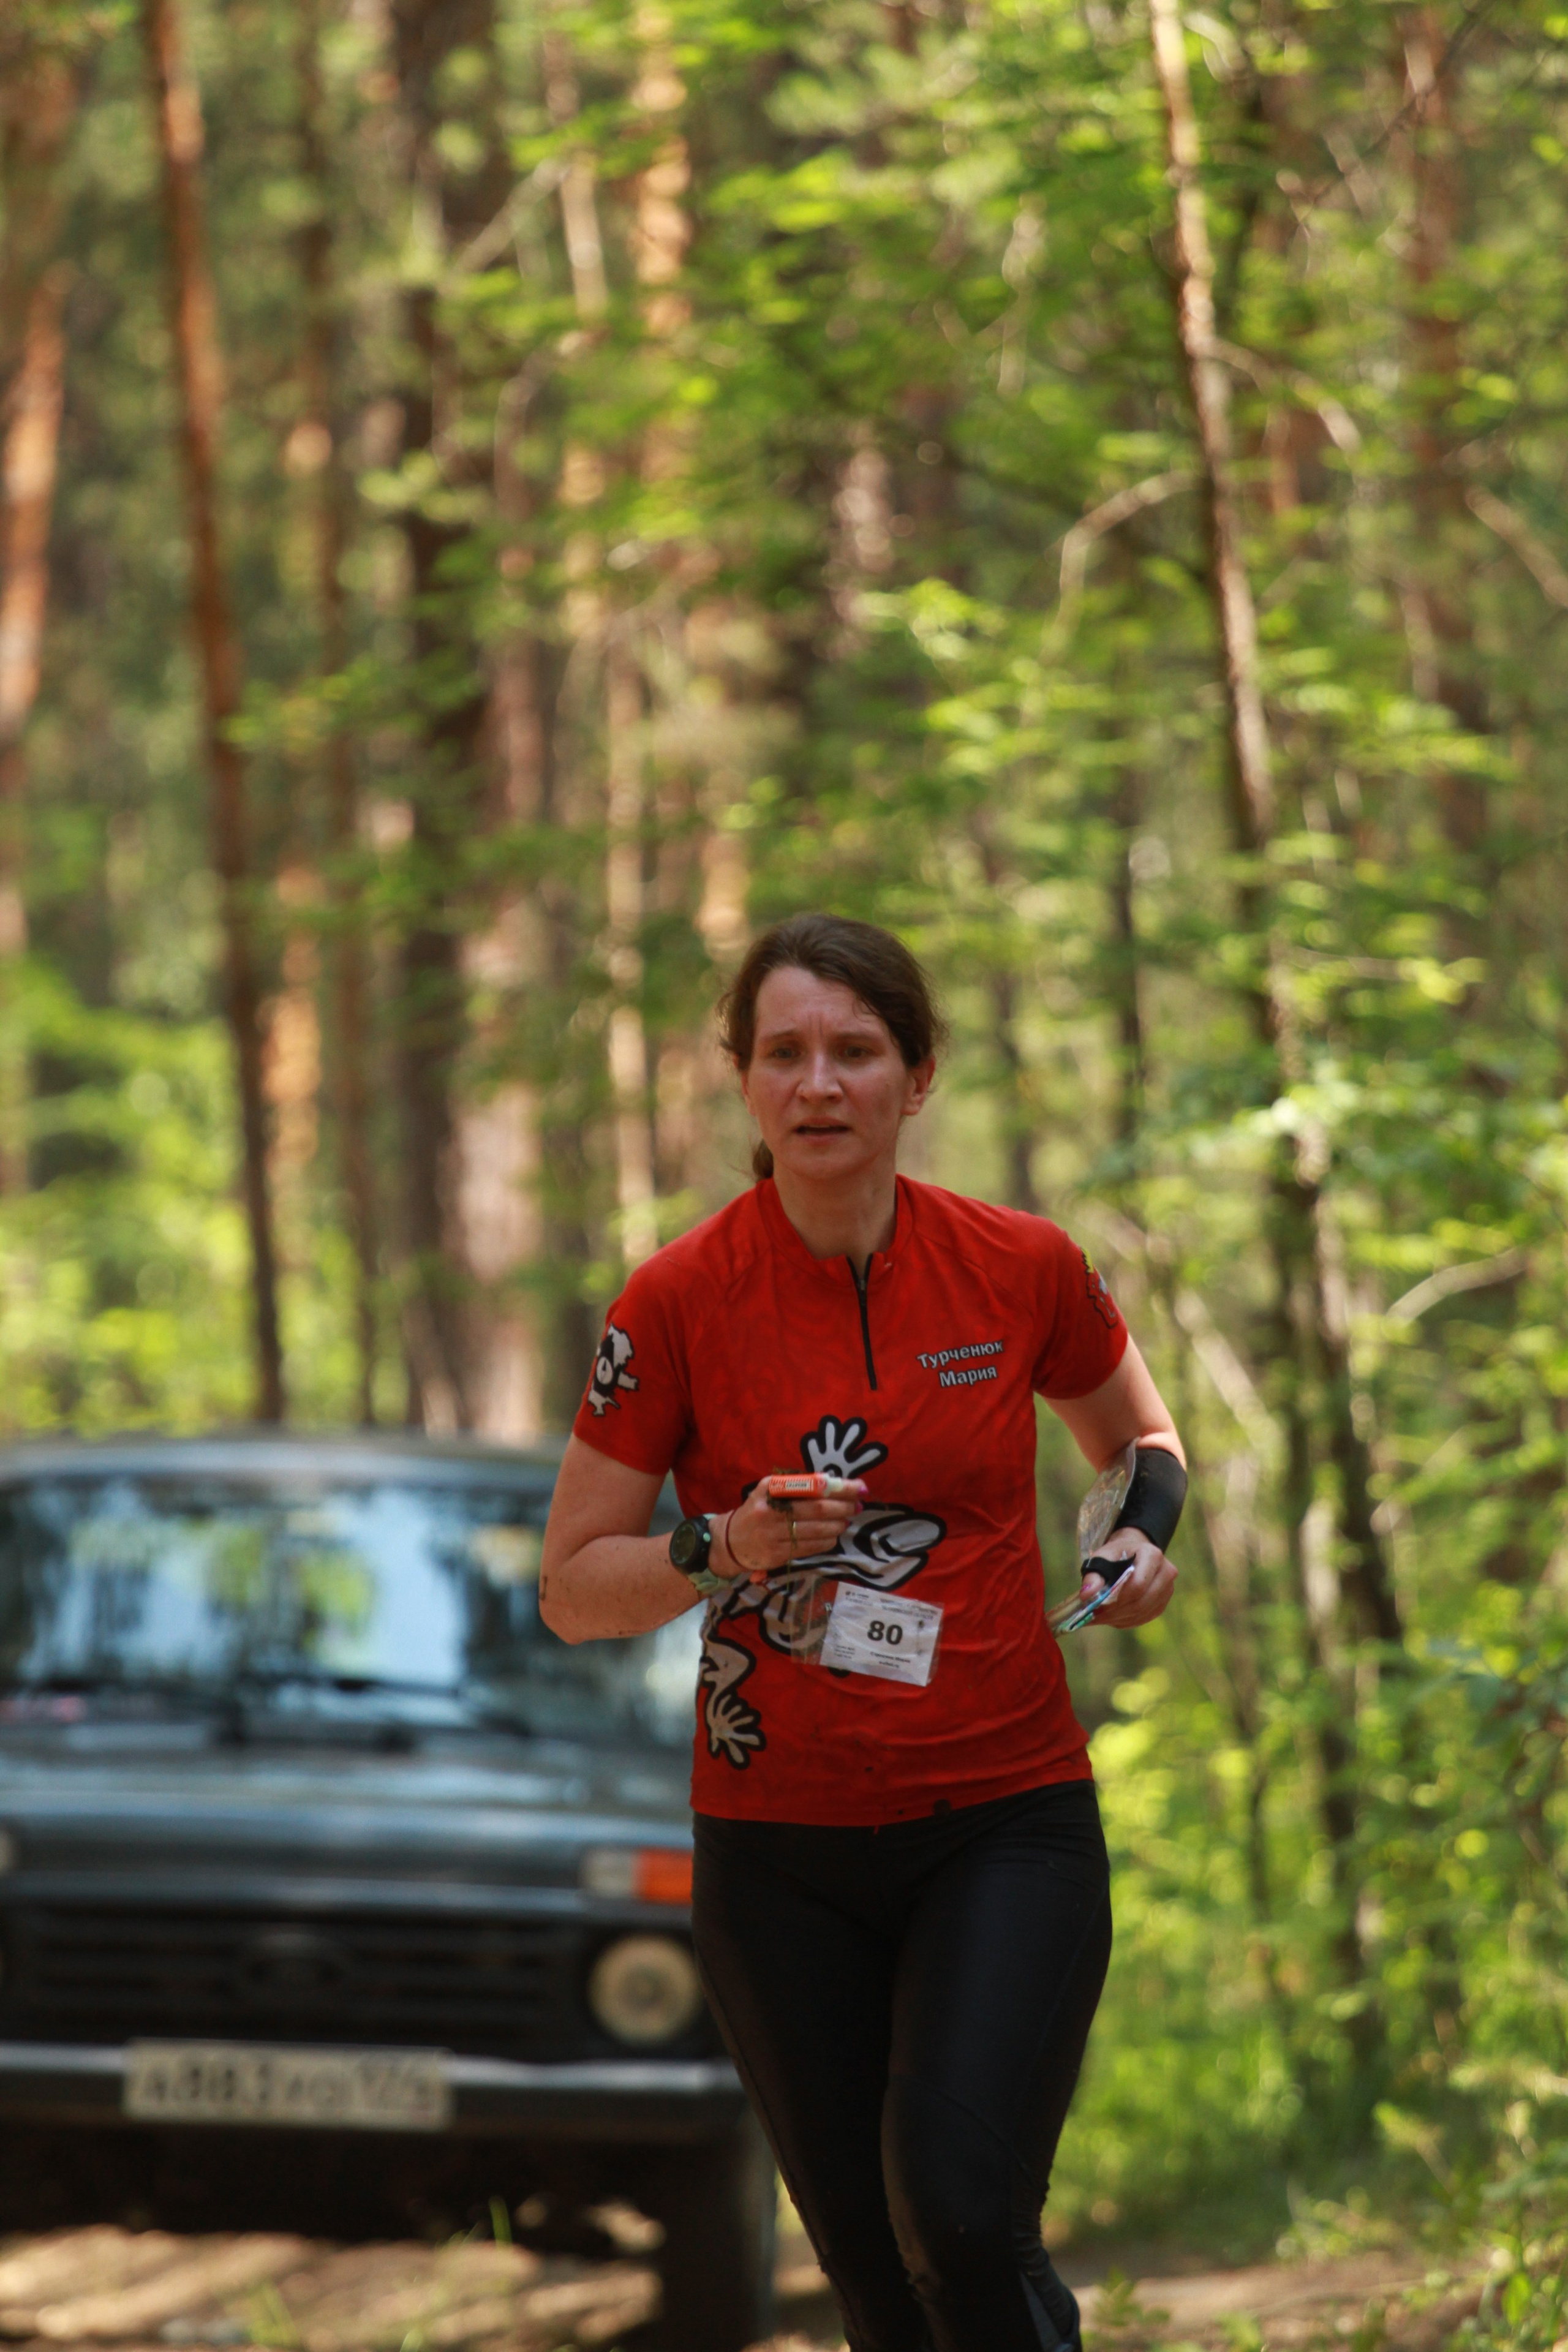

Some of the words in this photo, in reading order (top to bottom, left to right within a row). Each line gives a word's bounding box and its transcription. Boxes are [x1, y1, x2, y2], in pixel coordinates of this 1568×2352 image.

[917, 1340, 1003, 1369] Турченюк
[939, 1366, 998, 1387] Мария
[867, 1620, 903, 1645] 80
